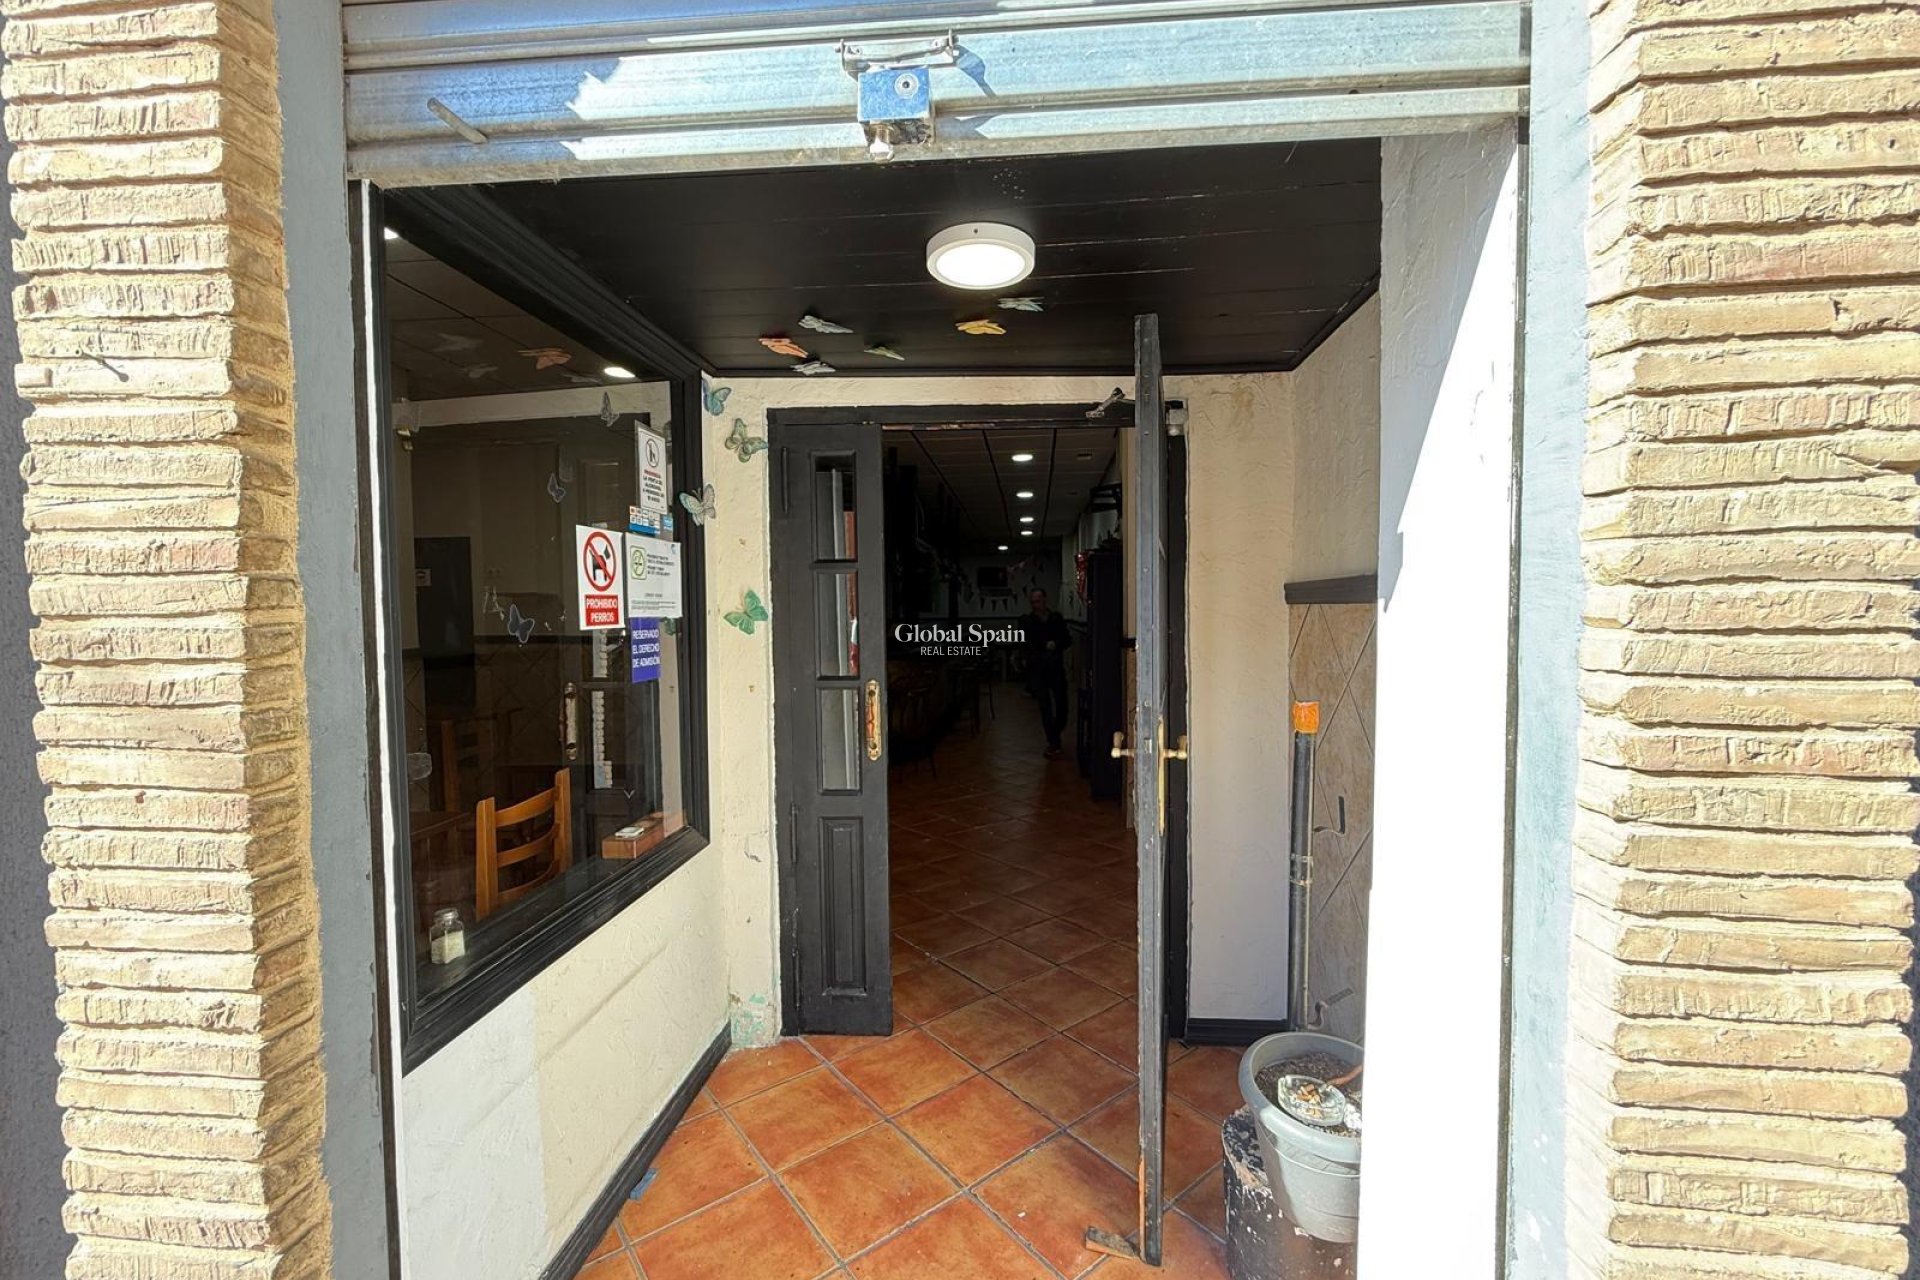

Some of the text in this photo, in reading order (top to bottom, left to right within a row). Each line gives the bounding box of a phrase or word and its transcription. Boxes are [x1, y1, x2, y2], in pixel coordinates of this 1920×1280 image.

[586, 598, 617, 609] PROHIBIDO
[591, 611, 615, 623] PERROS
[632, 629, 660, 639] RESERVADO
[632, 643, 660, 654] EL DERECHO
[632, 658, 640, 668] DE
